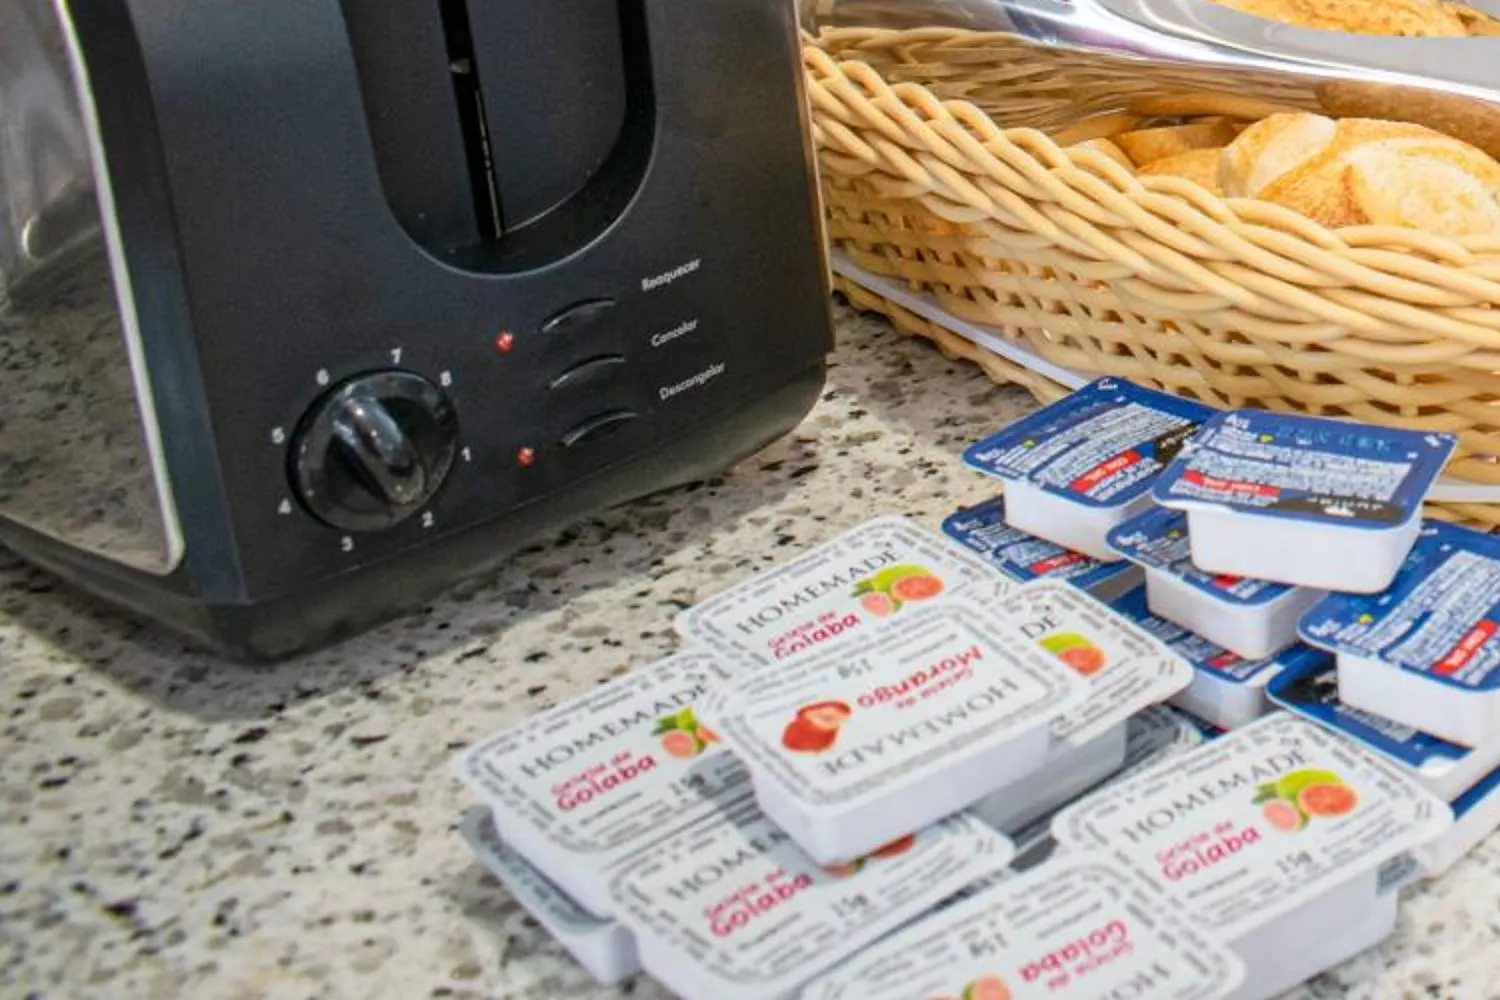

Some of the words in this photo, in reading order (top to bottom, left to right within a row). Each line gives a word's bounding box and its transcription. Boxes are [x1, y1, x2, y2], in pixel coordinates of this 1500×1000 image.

[651, 319, 698, 347] Cancelar
[390, 347, 402, 364] 7
[316, 368, 330, 386] 6
[440, 370, 452, 387] 8
[271, 427, 285, 444] 5
[462, 447, 471, 462] 1
[278, 499, 292, 515] 4
[422, 511, 434, 528] 2
[340, 536, 354, 552] 3
[736, 547, 905, 635] HOMEMADE
[857, 645, 984, 708] Morango
[821, 677, 1020, 776] HOMEMADE
[557, 754, 658, 813] Goiaba
[1121, 747, 1318, 844] HOMEMADE
[1162, 825, 1263, 882] Goiaba
[711, 872, 813, 937] Goiaba
[1019, 919, 1129, 984] Goiaba
